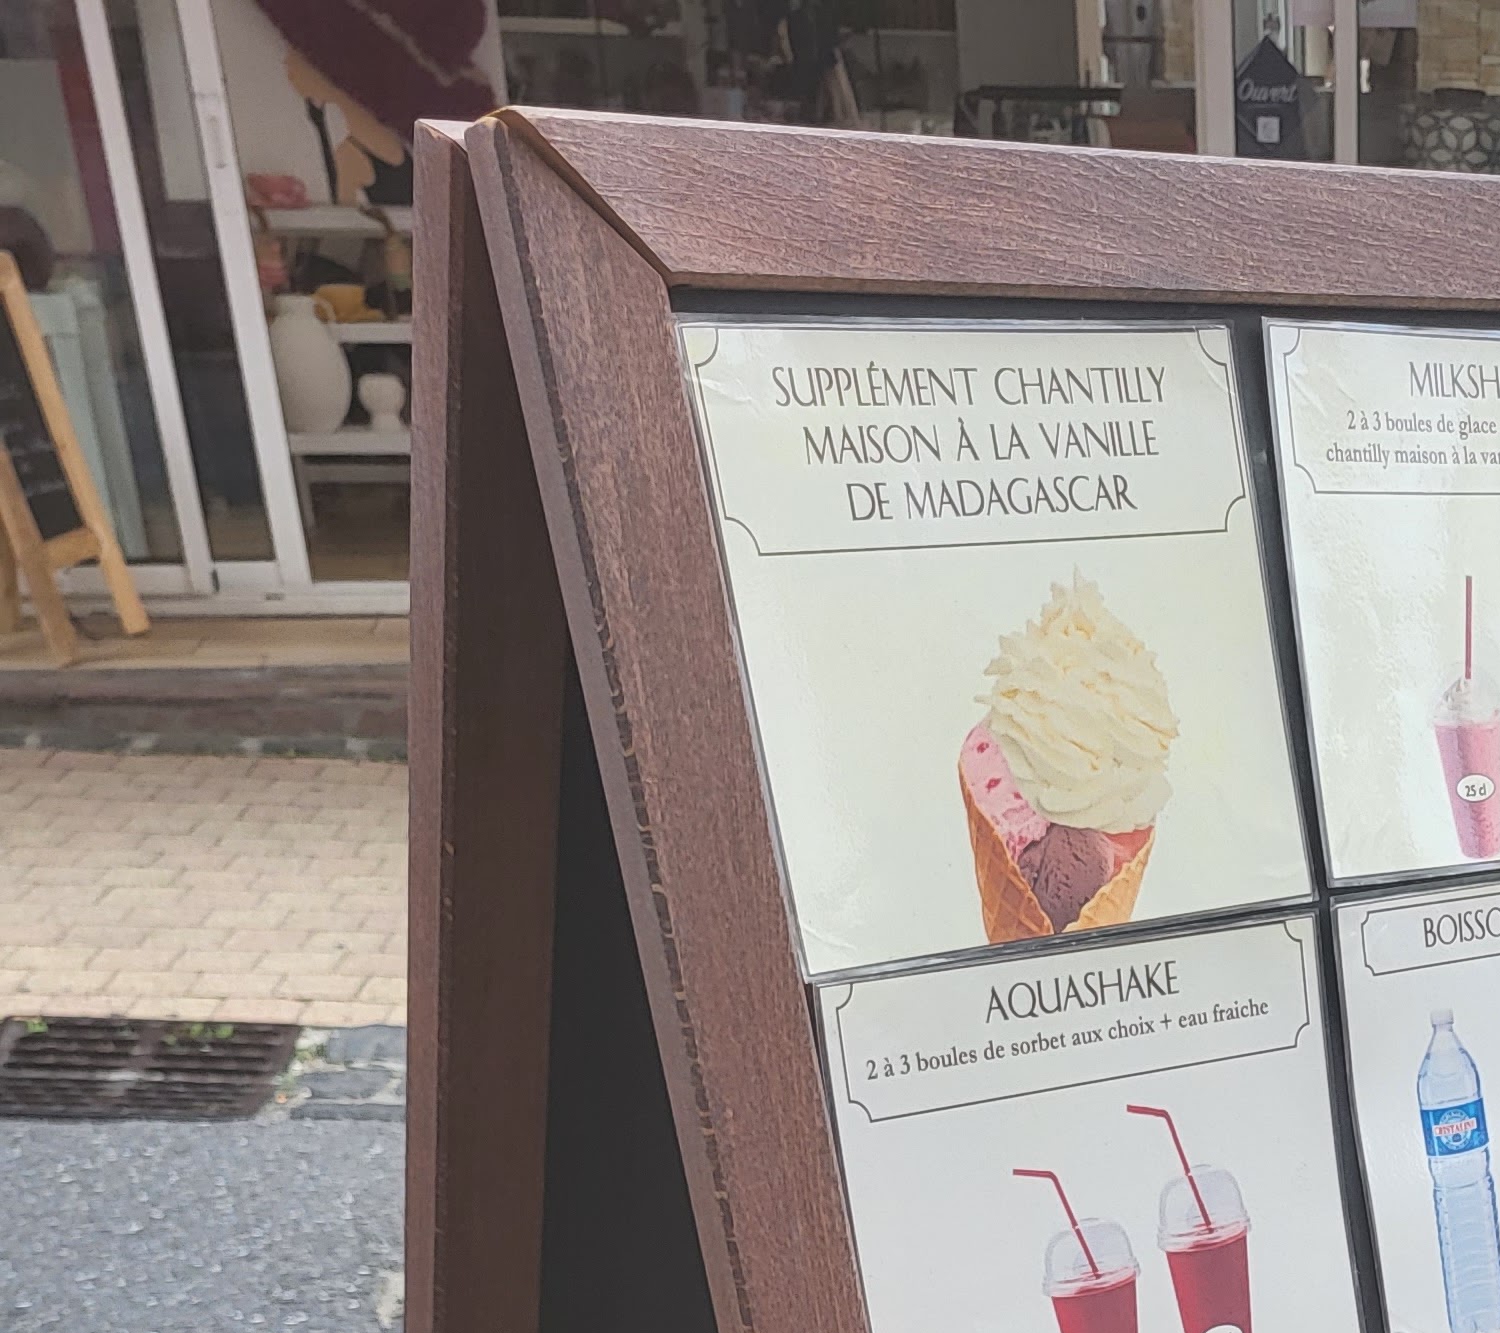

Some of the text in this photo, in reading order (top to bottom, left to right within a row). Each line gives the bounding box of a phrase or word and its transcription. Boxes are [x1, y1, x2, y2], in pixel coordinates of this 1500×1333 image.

[772, 361, 1165, 407] SUPPLÉMENT CHANTILLY
[803, 416, 1160, 465] MAISON À LA VANILLE
[1346, 410, 1356, 430] 2
[1360, 411, 1369, 431] à
[1372, 411, 1381, 431] 3
[1384, 411, 1433, 433] boules
[1437, 414, 1455, 433] de
[1459, 415, 1497, 440] glace
[1326, 442, 1390, 470] chantilly
[1394, 444, 1448, 465] maison
[1452, 446, 1460, 465] à
[1463, 446, 1477, 465] la
[846, 474, 1138, 521] DE MADAGASCAR
[1465, 784, 1477, 797] 25
[985, 960, 1180, 1024] AQUASHAKE
[866, 998, 1270, 1080] 2 à 3 boules de sorbet aux choix + eau fraiche
